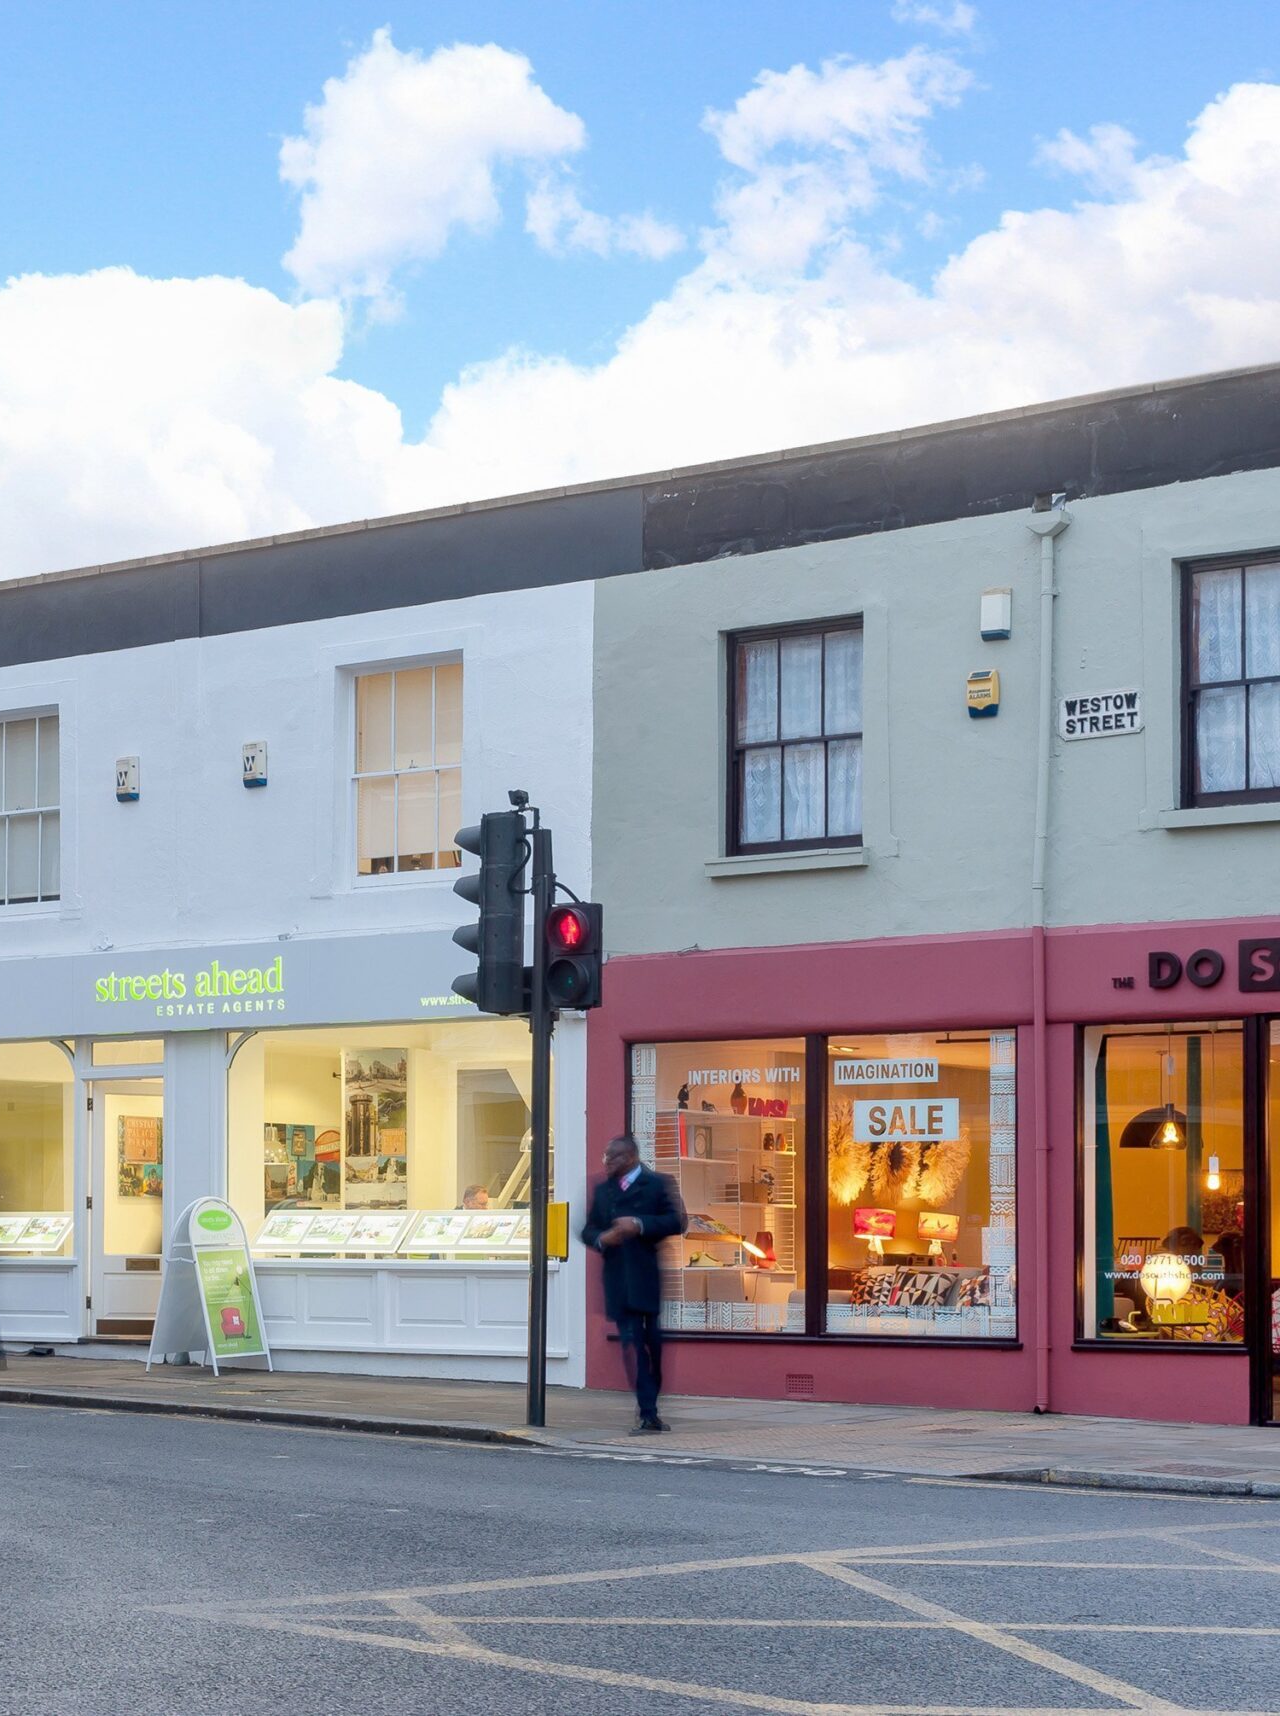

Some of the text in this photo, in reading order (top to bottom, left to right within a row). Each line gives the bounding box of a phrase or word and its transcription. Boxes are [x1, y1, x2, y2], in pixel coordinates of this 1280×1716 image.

[1065, 692, 1138, 717] WESTOW
[1066, 711, 1138, 735] STREET
[95, 955, 285, 1002] streets ahead
[1112, 947, 1280, 989] THE DO S
[156, 999, 286, 1017] ESTATE AGENTS
[688, 1066, 801, 1086] INTERIORS WITH
[837, 1062, 935, 1081] IMAGINATION
[868, 1104, 944, 1136] SALE
[1120, 1254, 1205, 1266] 020 8771 0500
[1104, 1270, 1225, 1282] www.dosouthshop.com
